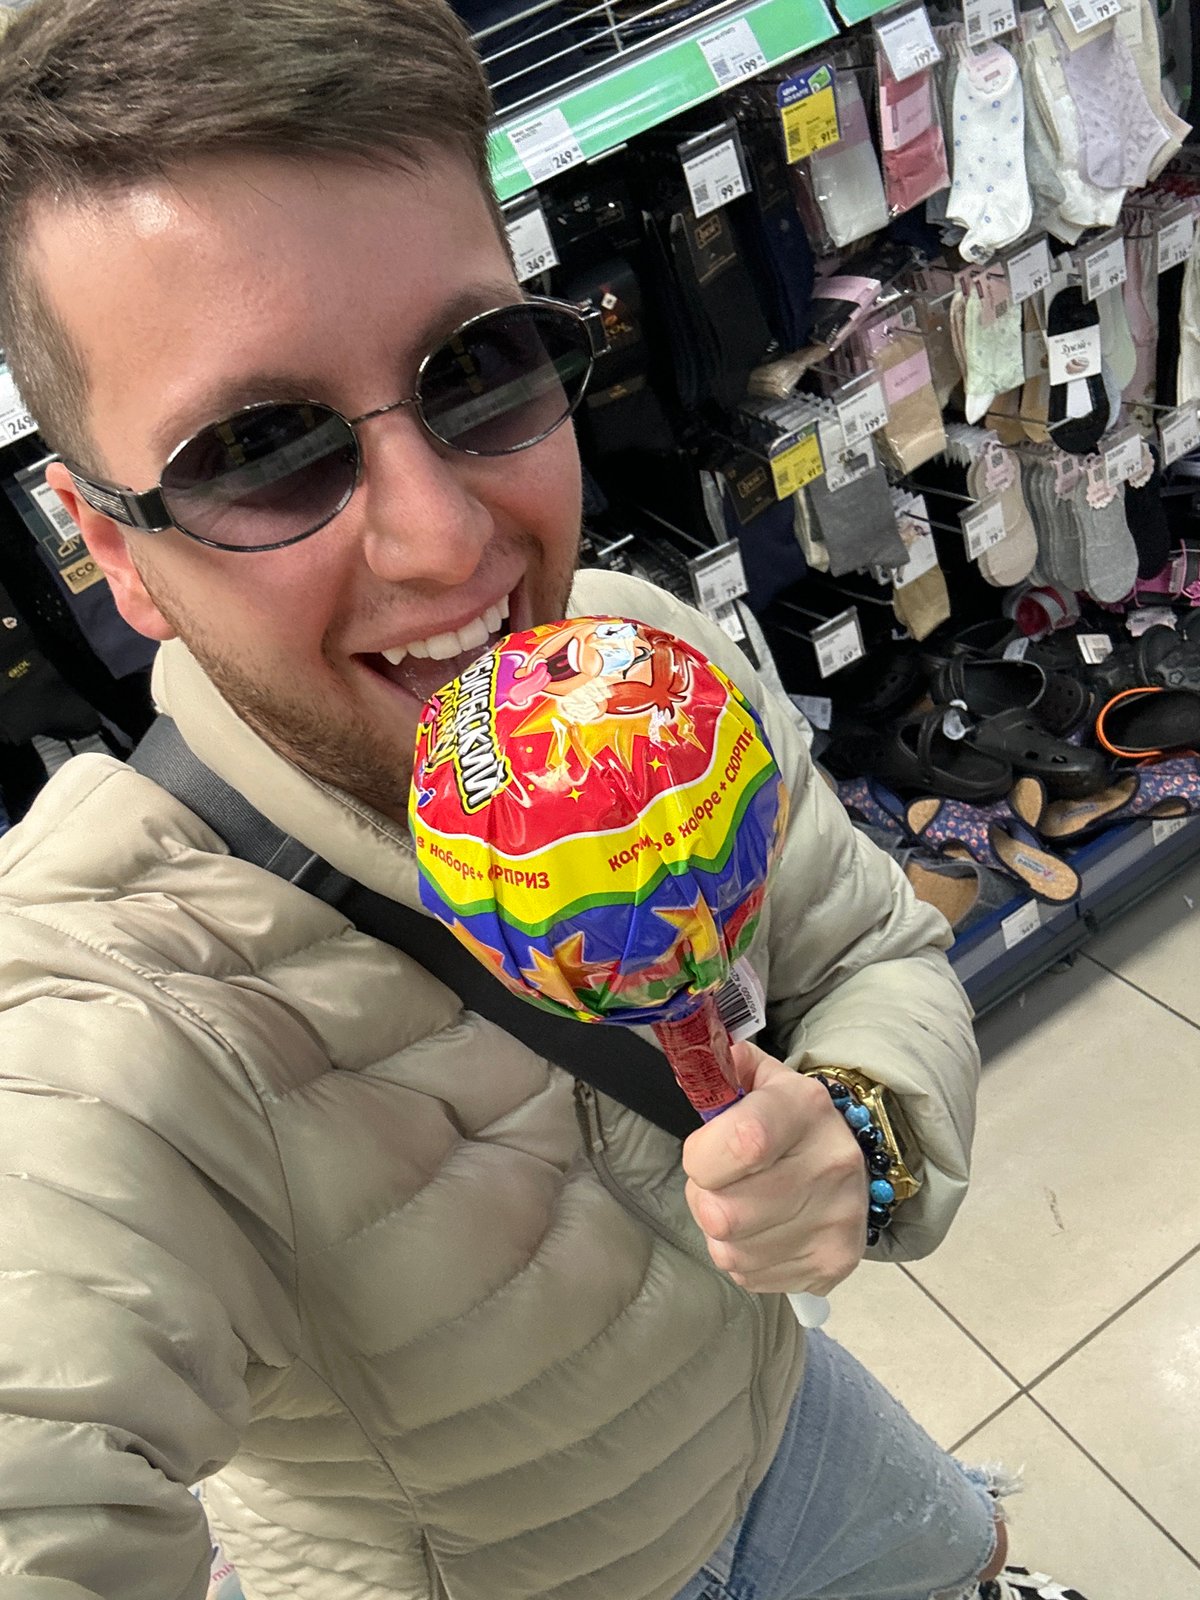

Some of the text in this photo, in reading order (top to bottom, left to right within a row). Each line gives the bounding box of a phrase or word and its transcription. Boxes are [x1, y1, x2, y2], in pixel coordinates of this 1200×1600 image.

[738, 58, 757, 75] 199
[552, 150, 573, 169] 249
[525, 255, 546, 274] 349
[67, 561, 96, 583] ECO
